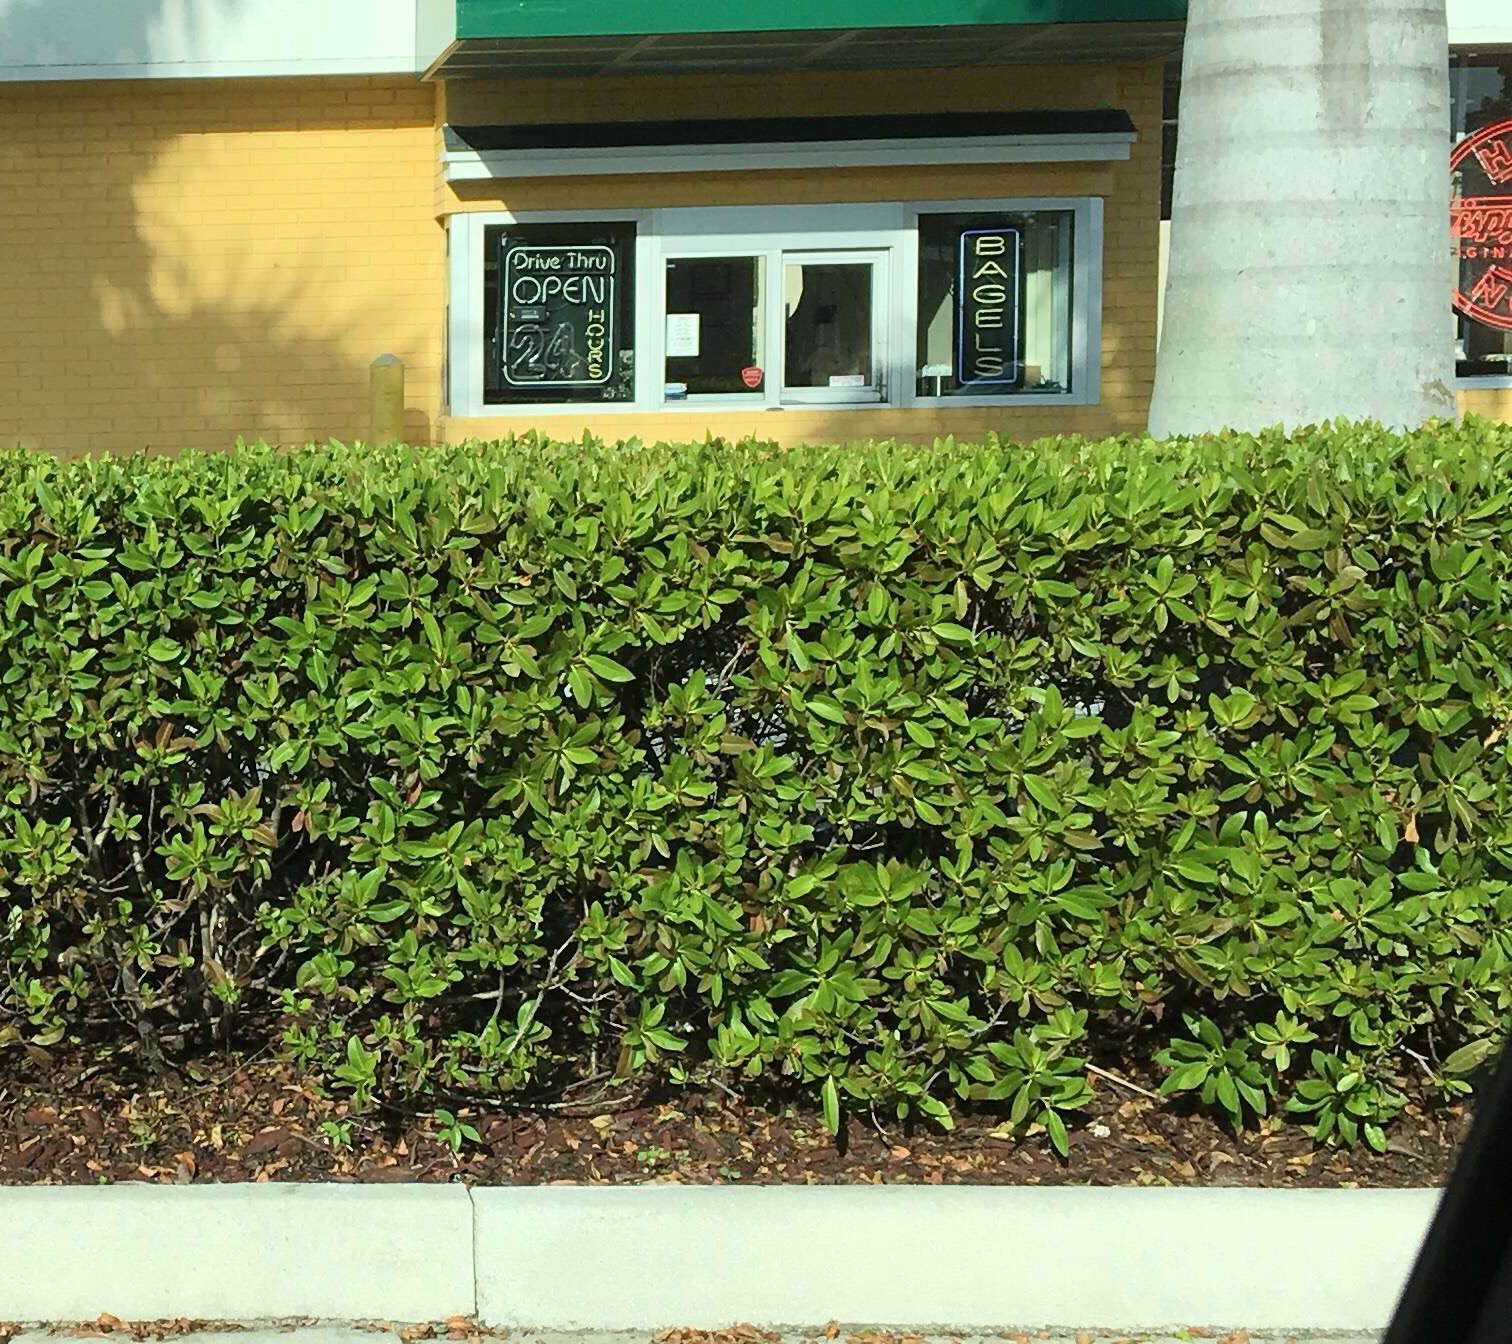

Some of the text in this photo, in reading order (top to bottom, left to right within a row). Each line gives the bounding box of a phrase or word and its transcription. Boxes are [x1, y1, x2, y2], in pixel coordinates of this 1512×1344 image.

[512, 251, 607, 270] Drive Thru
[512, 275, 605, 305] OPEN
[973, 236, 1008, 378] BAGELS
[510, 322, 580, 380] 24
[586, 309, 606, 379] HOURS
